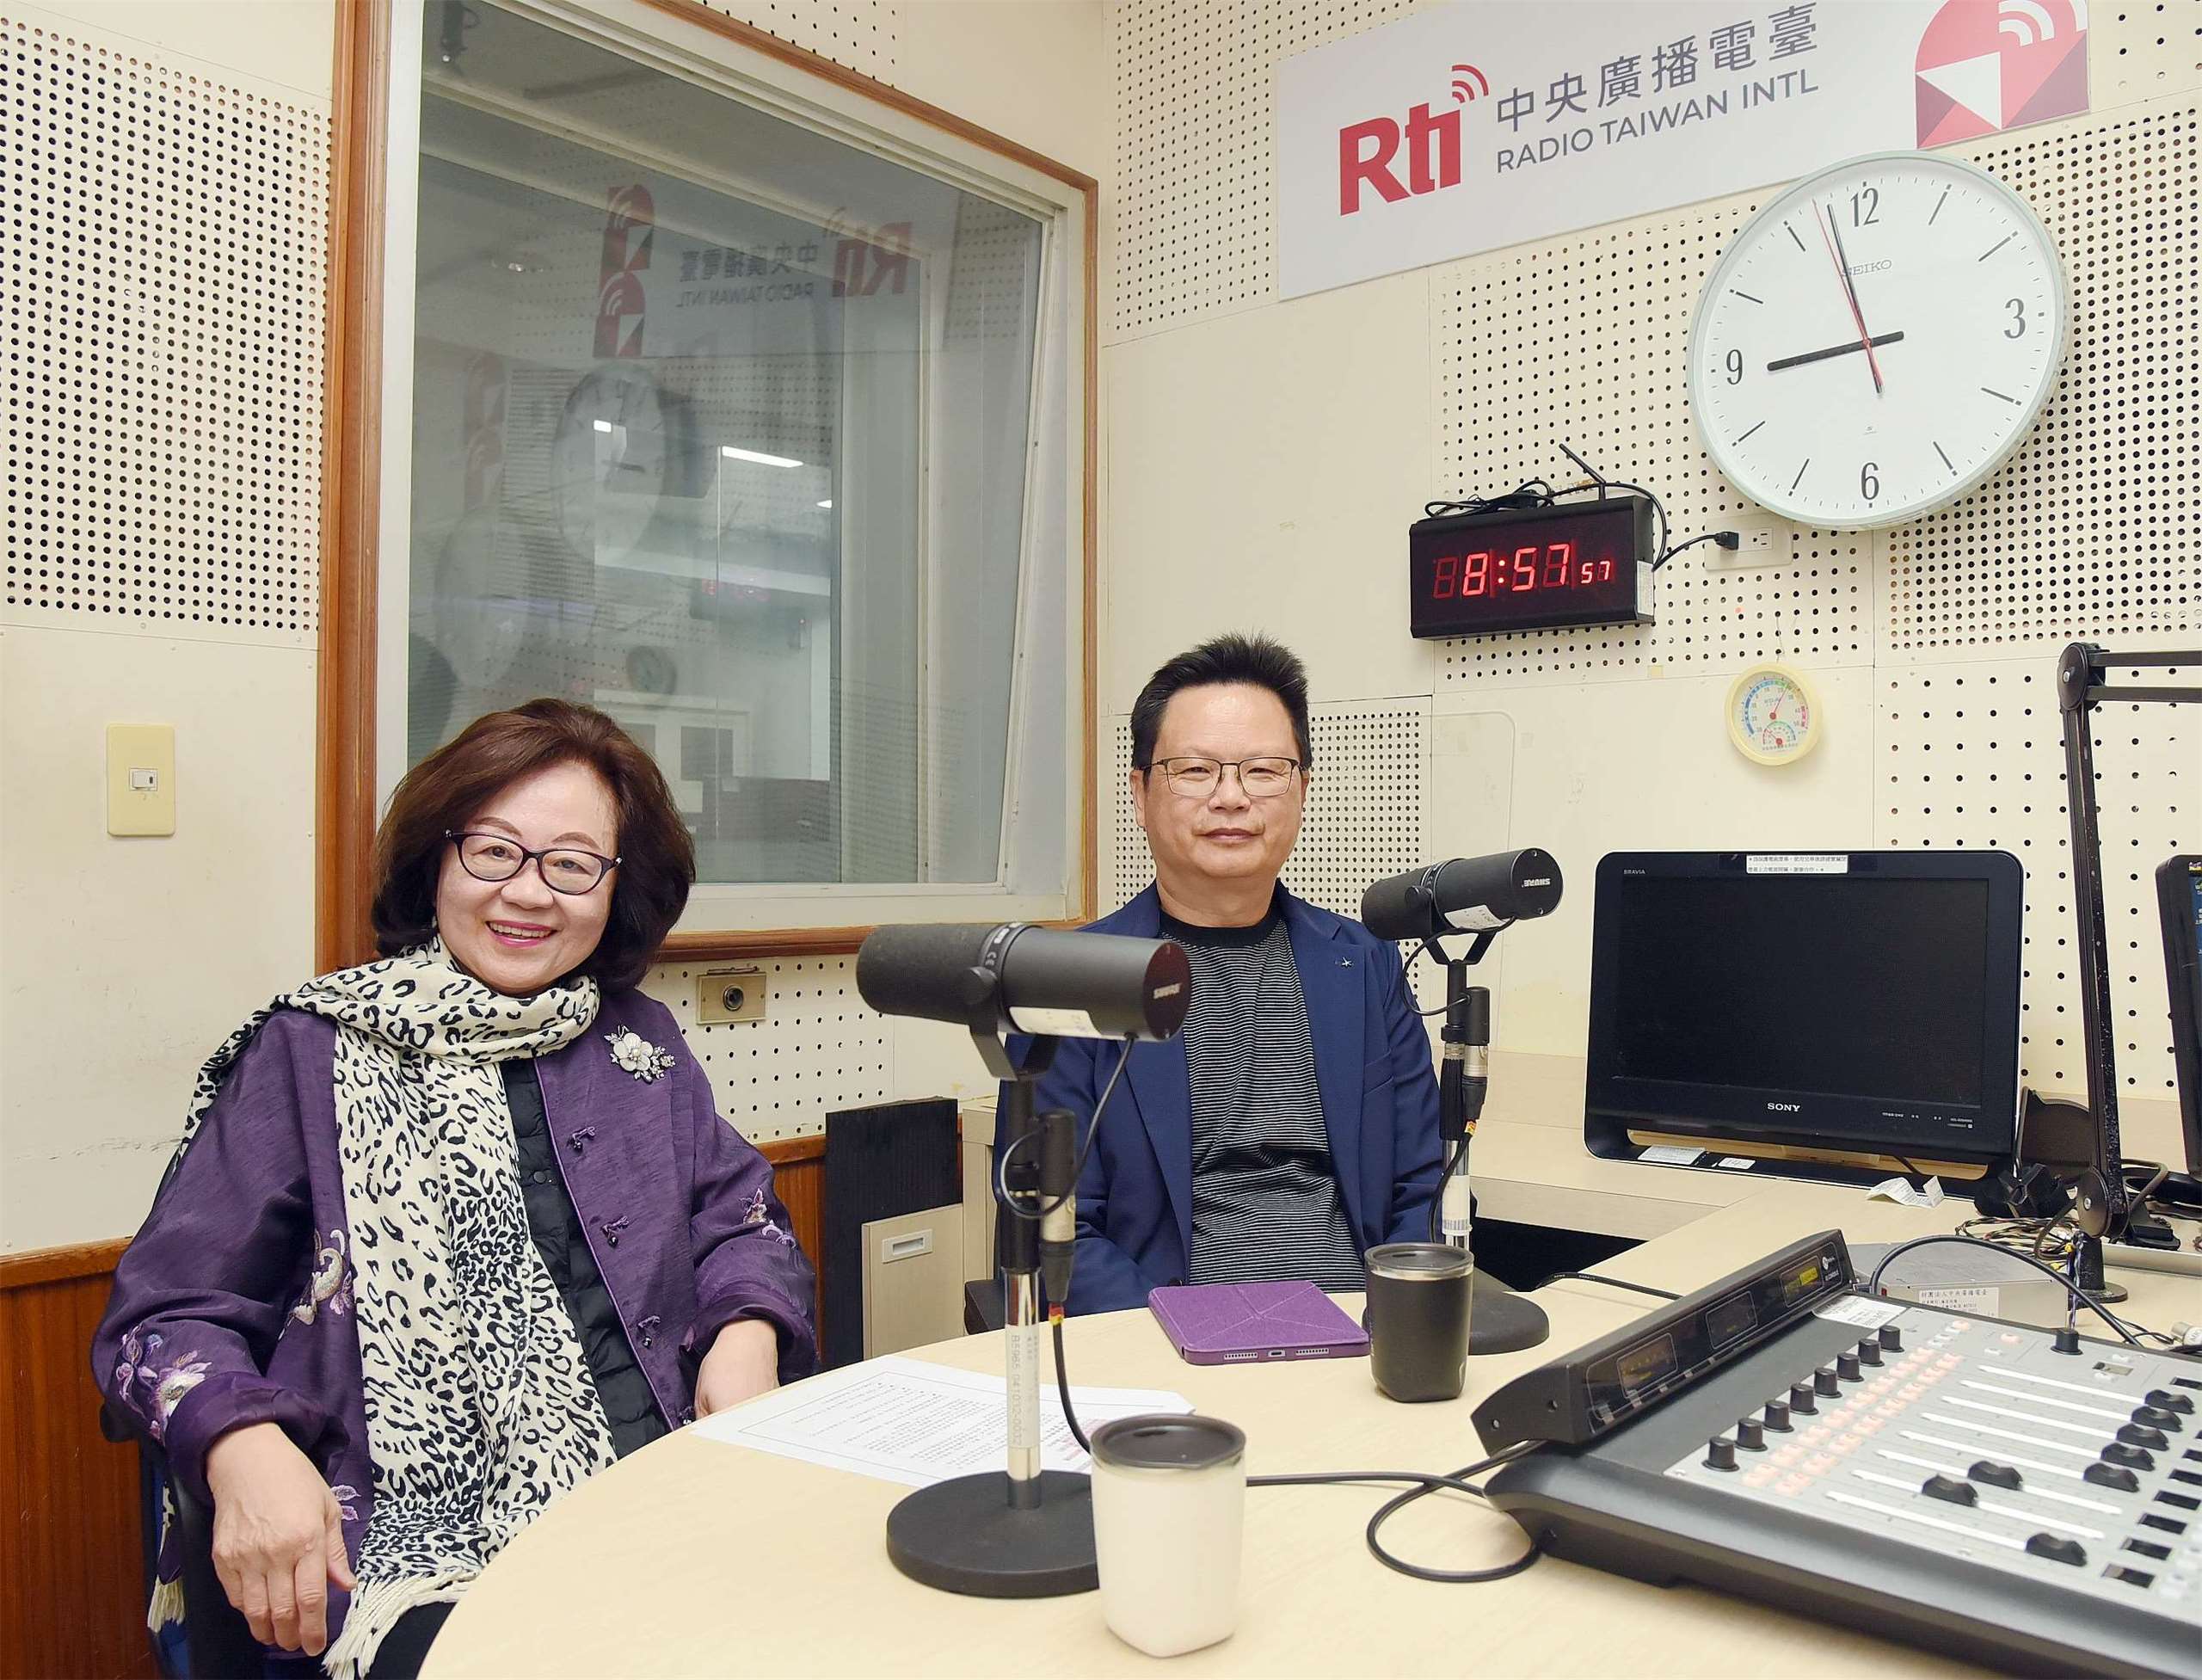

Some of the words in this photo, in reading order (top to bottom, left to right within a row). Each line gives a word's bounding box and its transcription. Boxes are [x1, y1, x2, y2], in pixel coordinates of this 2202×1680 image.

[1498, 3, 1818, 132] 中央廣播電臺
[1497, 128, 1593, 173] RADIO
[1599, 90, 1728, 145] TAIWAN
[1743, 69, 1818, 109] INTL
[1340, 102, 1461, 216] Rti
[1850, 187, 1879, 227] 12
[2003, 298, 2027, 339] 3
[1725, 348, 1744, 385] 9
[1861, 462, 1879, 501] 6
[1462, 543, 1571, 596] 8:57
[1581, 560, 1610, 584] 57
[1767, 1102, 1800, 1112] SONY
